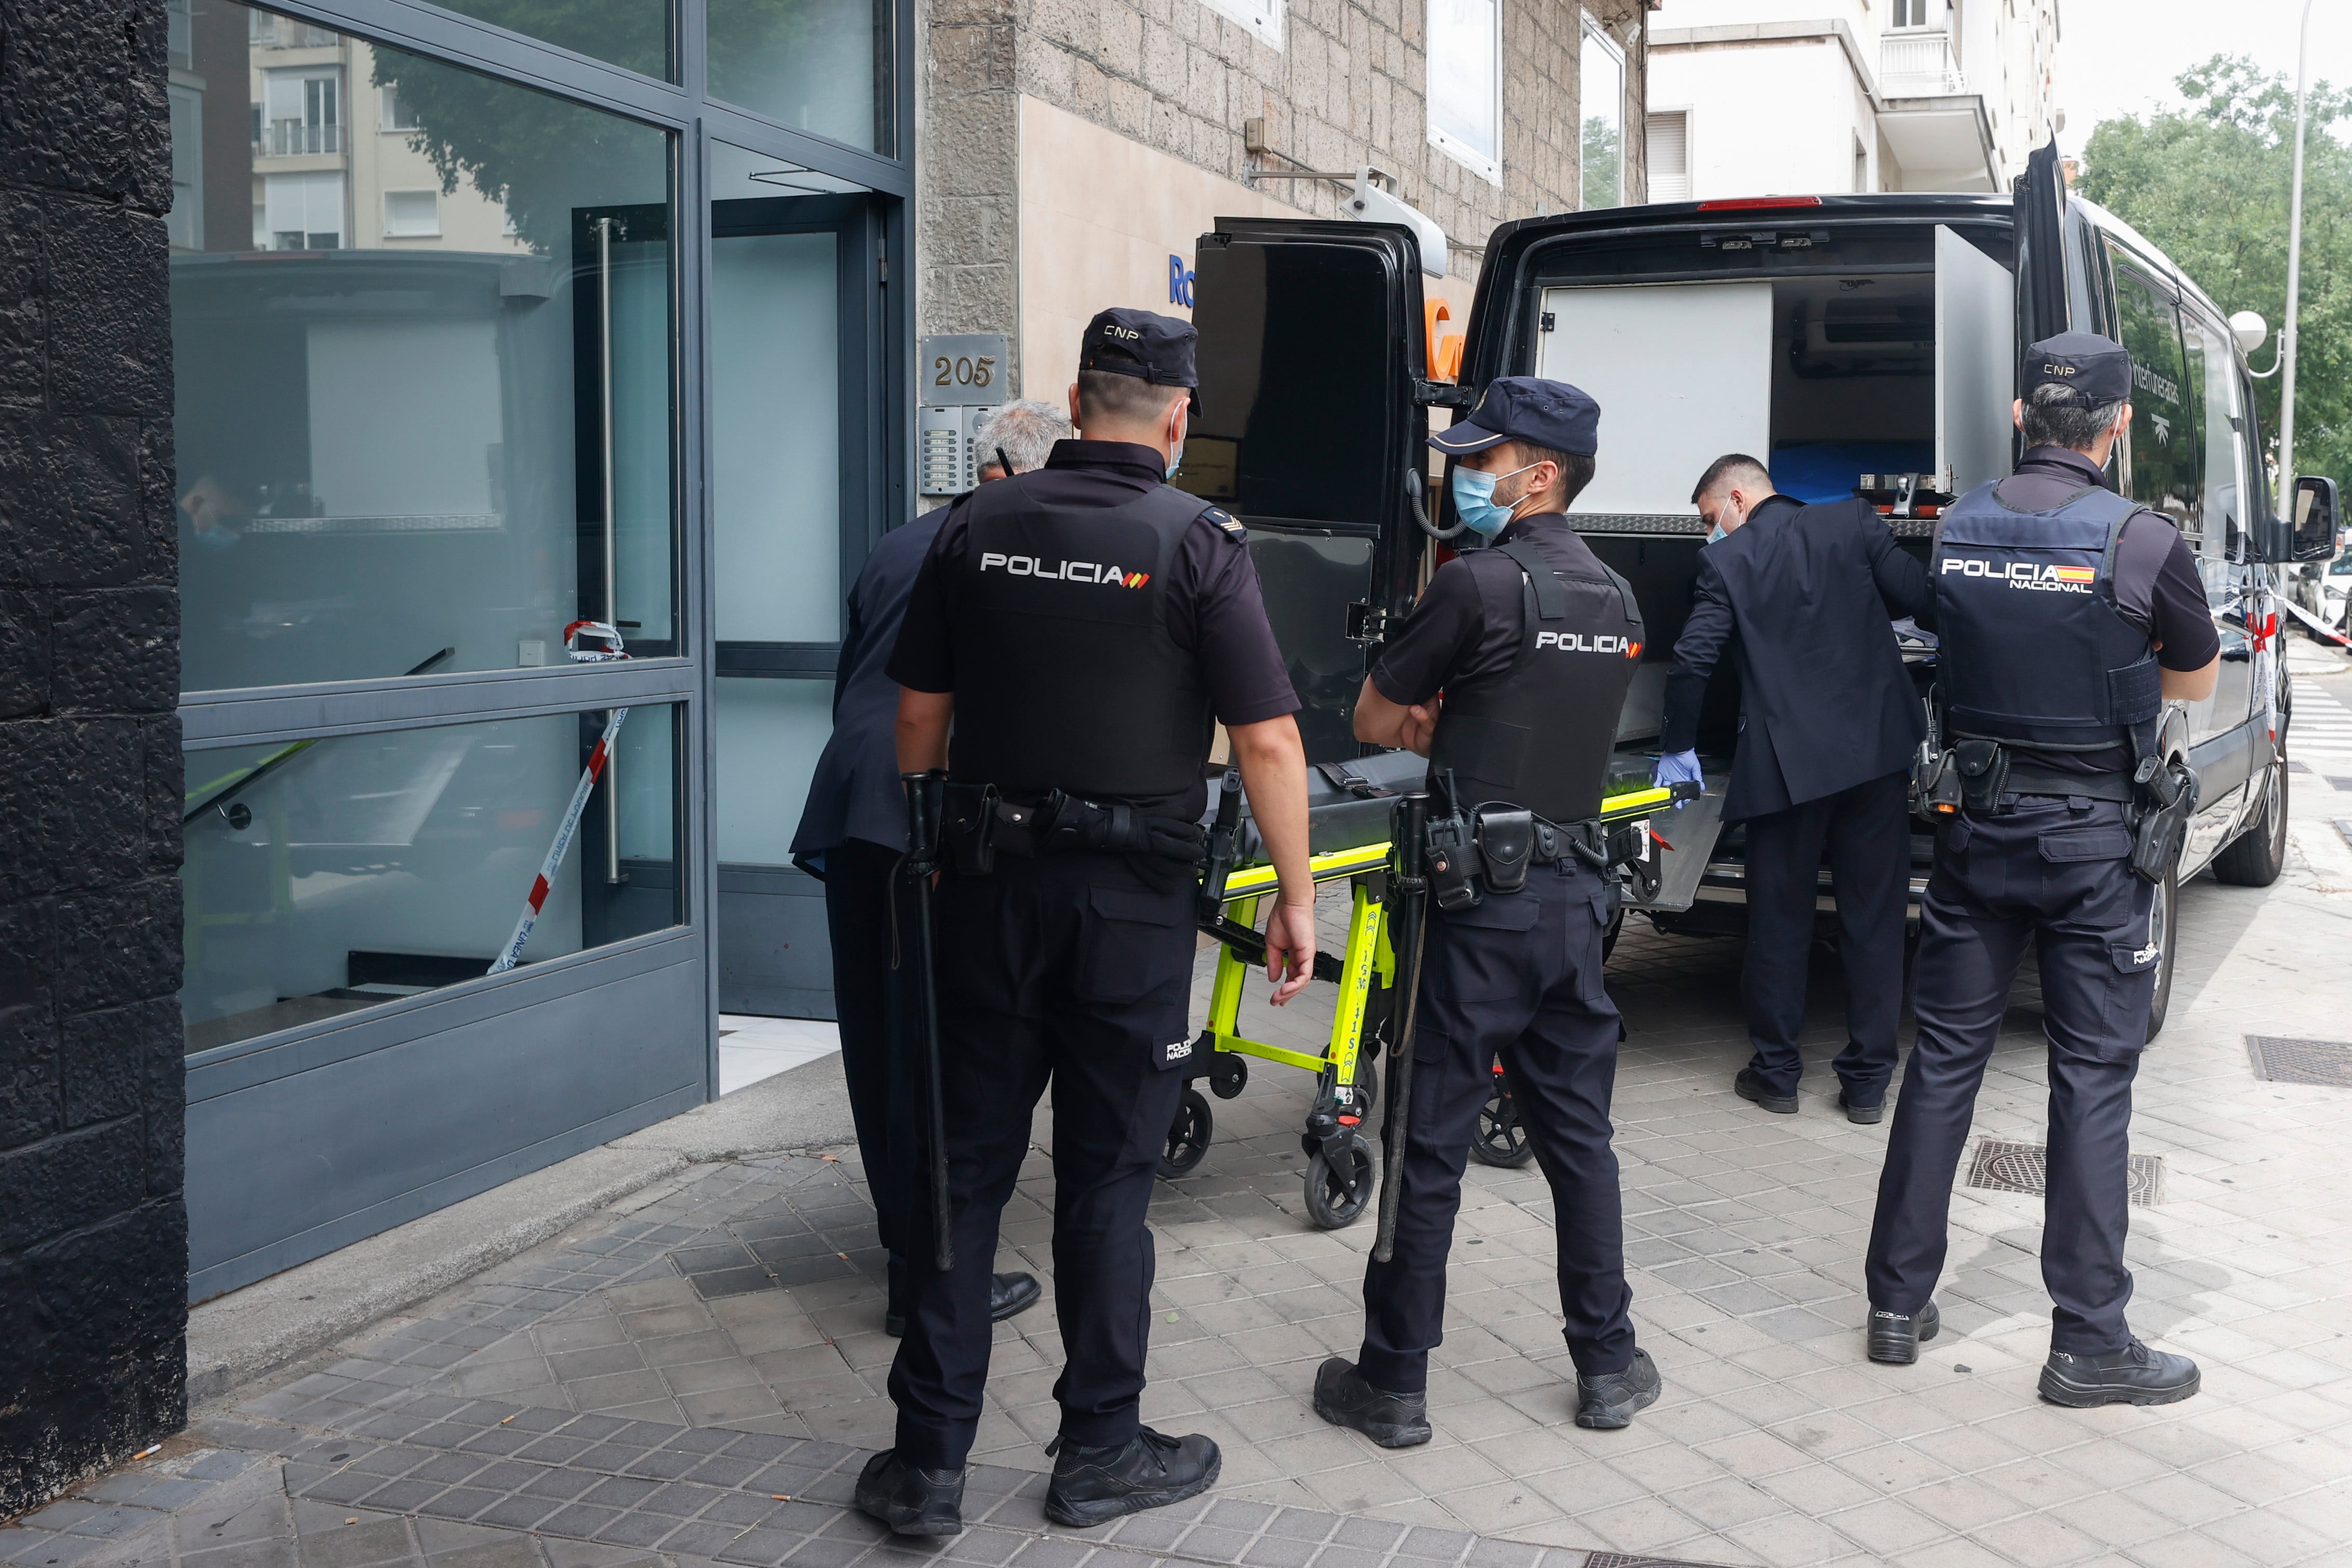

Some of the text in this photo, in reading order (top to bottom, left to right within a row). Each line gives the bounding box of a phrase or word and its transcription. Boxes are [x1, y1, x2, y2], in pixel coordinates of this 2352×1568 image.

[1169, 254, 1195, 308] Ro
[1104, 325, 1139, 340] CNP
[935, 355, 996, 387] 205
[2044, 364, 2076, 377] CNP
[980, 552, 1124, 586] POLICIA
[1941, 558, 2061, 582] POLICIA
[2010, 579, 2093, 594] NACIONAL
[1535, 631, 1629, 654] POLICIA
[511, 931, 528, 958] LINEA
